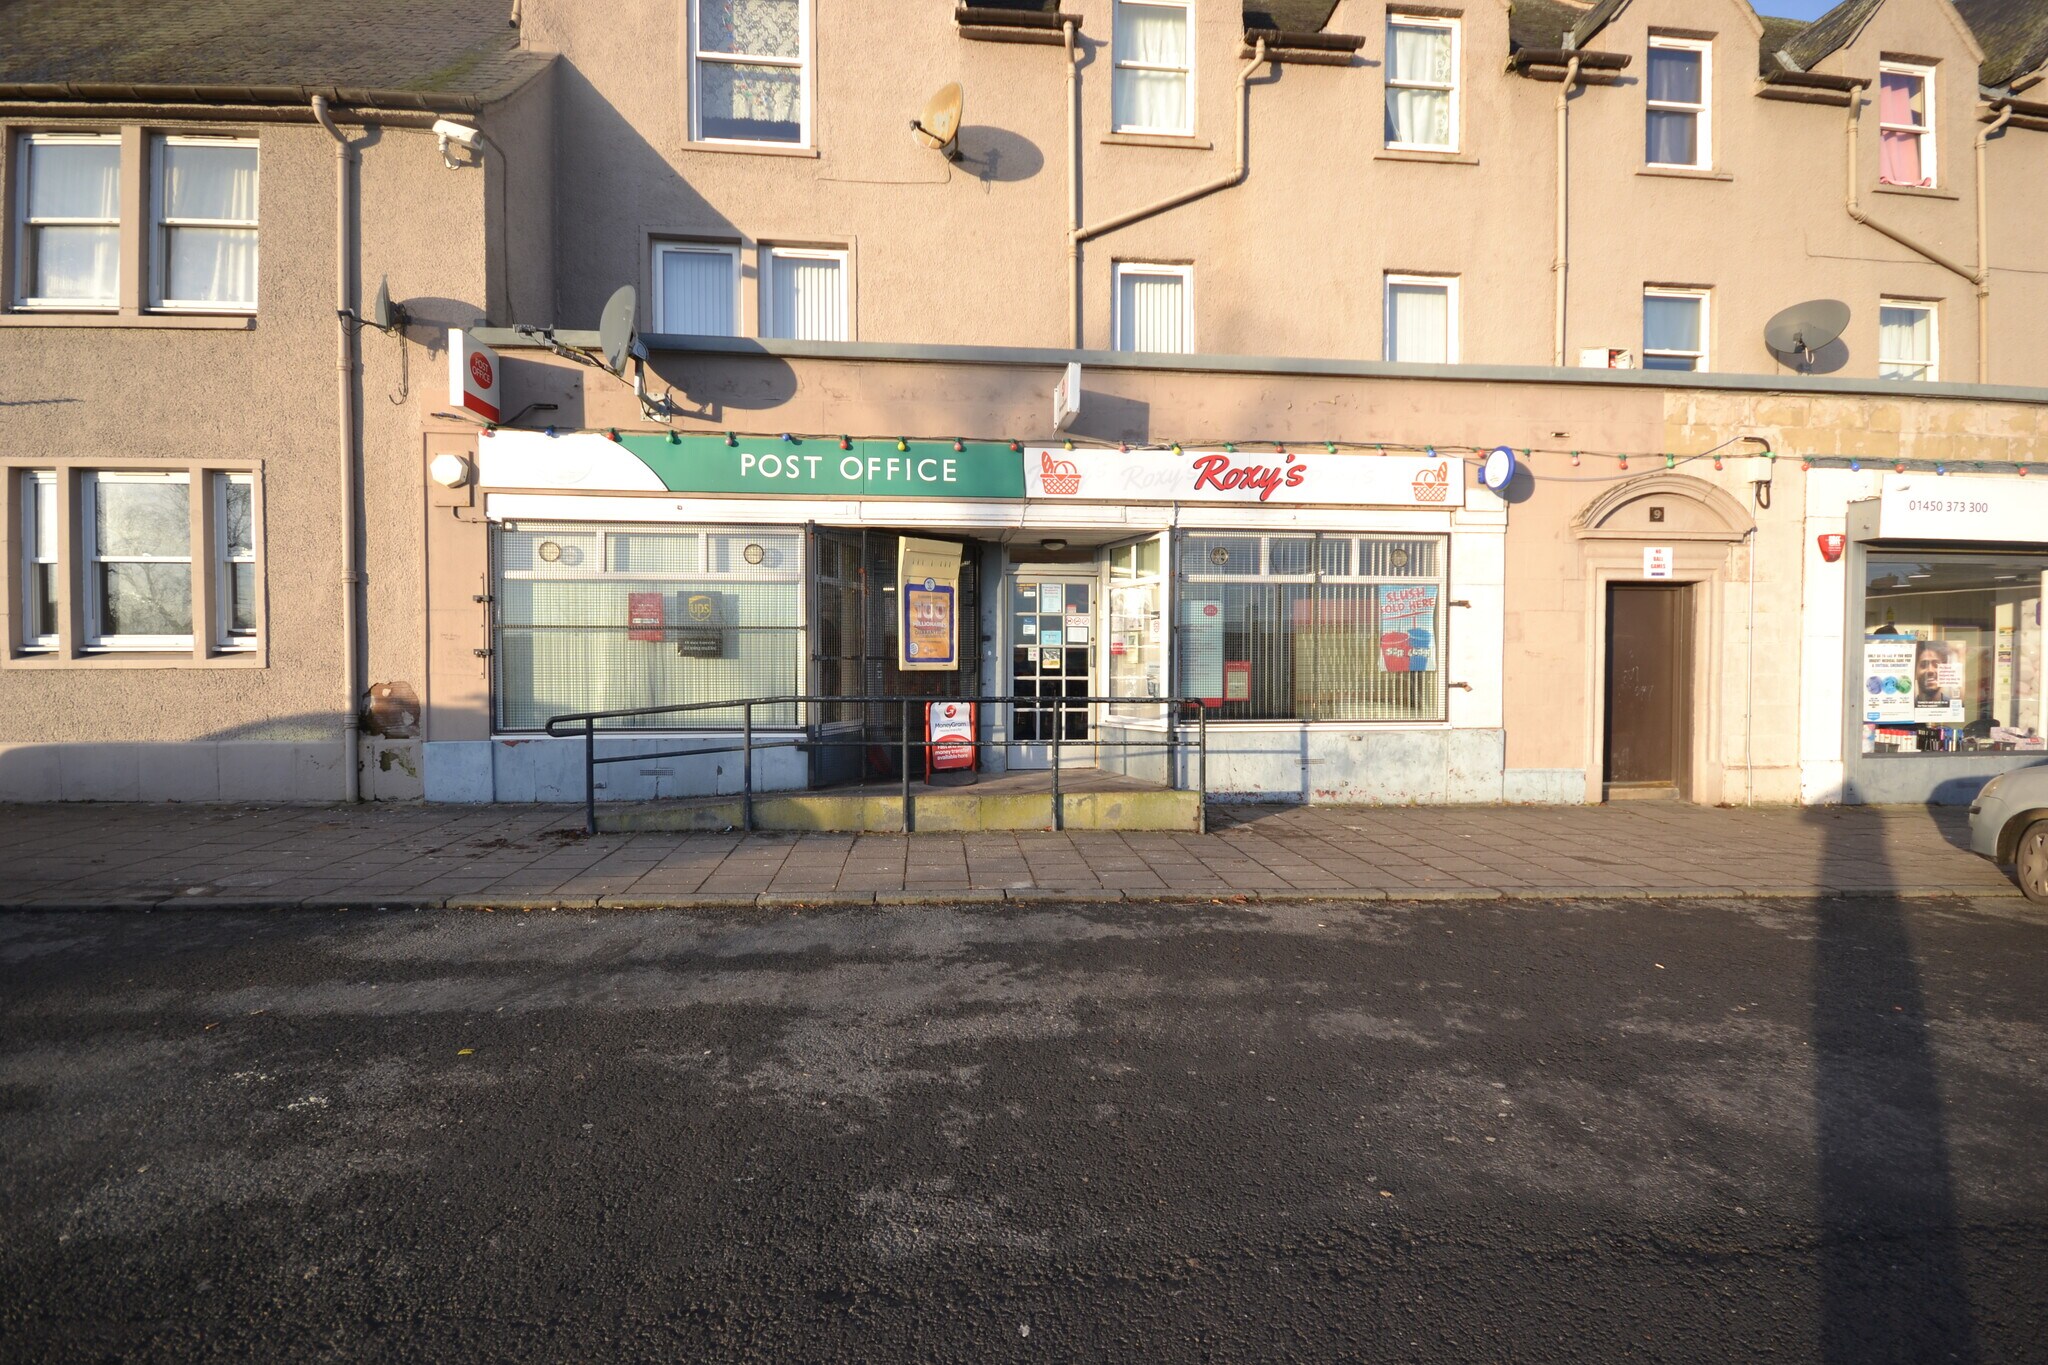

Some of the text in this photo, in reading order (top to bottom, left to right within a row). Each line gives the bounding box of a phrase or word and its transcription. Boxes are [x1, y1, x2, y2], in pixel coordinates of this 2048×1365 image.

[474, 357, 488, 372] POST
[472, 366, 490, 384] OFFICE
[741, 453, 957, 482] POST OFFICE
[1192, 453, 1307, 502] Roxy's
[1654, 509, 1662, 519] 9
[1909, 500, 1988, 513] 01450 373 300
[1386, 586, 1425, 602] SLUSH
[690, 604, 710, 618] ups
[913, 601, 946, 619] 100
[1409, 597, 1436, 610] HERE
